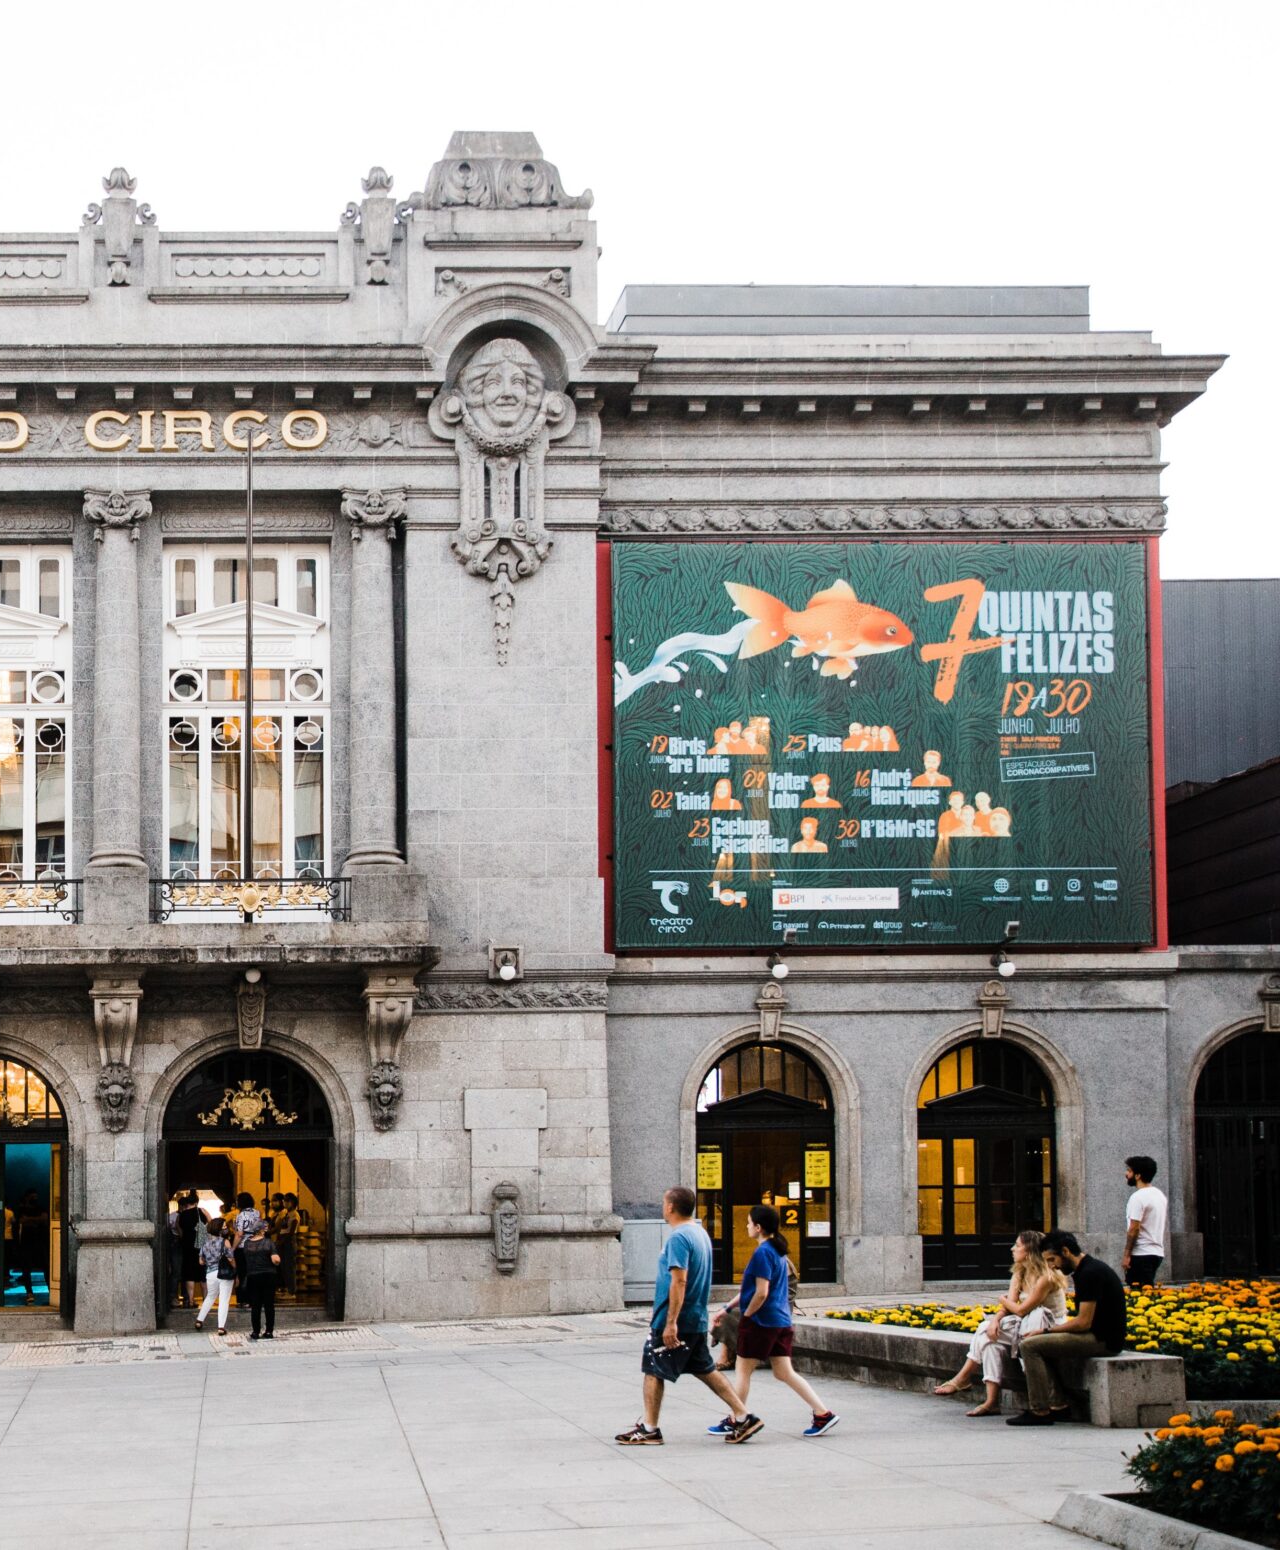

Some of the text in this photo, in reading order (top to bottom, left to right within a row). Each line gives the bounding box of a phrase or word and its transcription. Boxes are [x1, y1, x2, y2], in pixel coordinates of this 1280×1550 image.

[84, 409, 328, 452] CIRCO
[978, 591, 1114, 634] QUINTAS
[921, 578, 1014, 705] 7
[1001, 633, 1114, 673] FELIZES
[1043, 679, 1092, 717] 30
[998, 718, 1080, 734] JUNHO JULHO
[668, 737, 706, 755] Birds
[782, 734, 842, 752] 25 Paus
[668, 755, 730, 773] are Indie
[786, 752, 805, 760] JUNHO
[1006, 759, 1057, 770] ESPETÁCULOS
[854, 768, 911, 788] 16 André
[1007, 763, 1090, 777] CORONACOMPATÍVEIS
[743, 769, 809, 790] 09 Valter
[651, 790, 710, 810] 02 Tainá
[768, 791, 800, 809] Lobo
[852, 789, 869, 797] JULHO
[871, 787, 939, 808] Henriques
[654, 809, 672, 818] JULHO
[688, 817, 770, 838] 23 Cachupa
[835, 819, 860, 840] 30
[692, 838, 709, 846] JULHO
[711, 834, 789, 853] Psicadélica
[840, 839, 858, 848] JULHO
[791, 894, 805, 903] BPI
[946, 888, 953, 897] 3
[649, 917, 694, 926] theatro
[658, 925, 687, 934] circo
[786, 1209, 798, 1224] 2
